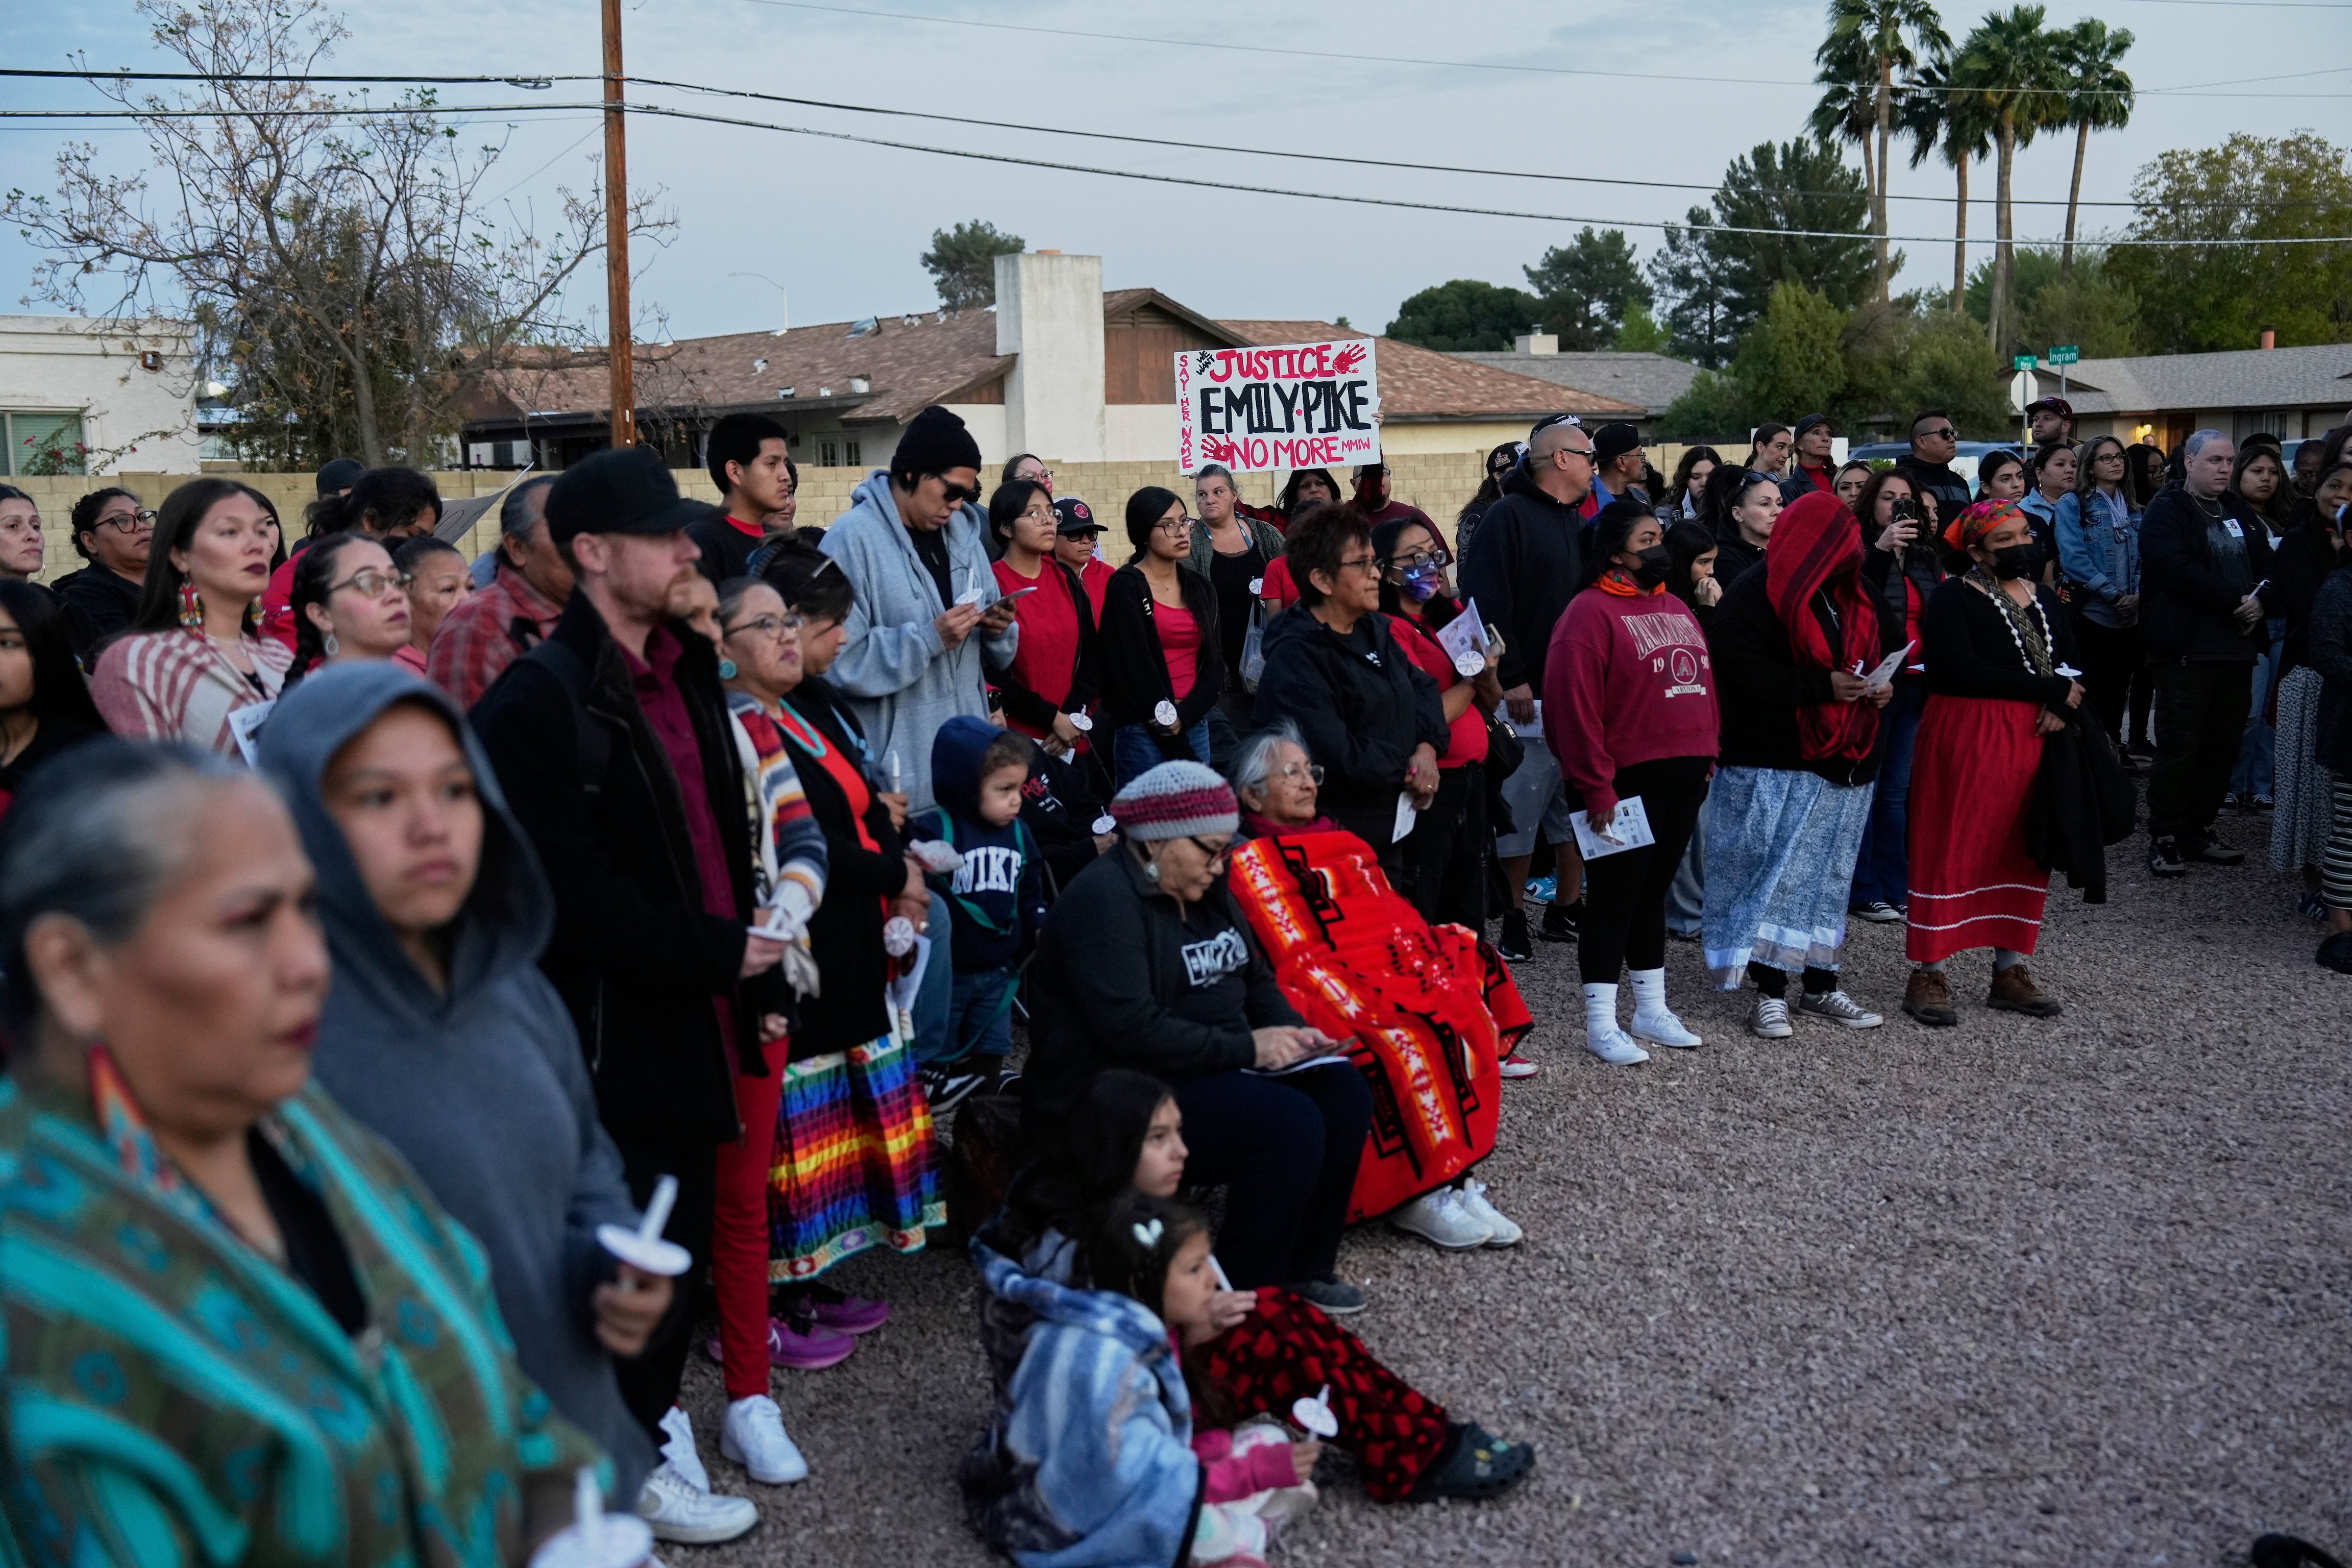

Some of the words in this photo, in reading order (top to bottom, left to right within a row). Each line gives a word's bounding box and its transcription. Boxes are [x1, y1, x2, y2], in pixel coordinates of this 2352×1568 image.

[1195, 354, 1215, 375] WANT
[1196, 351, 1210, 363] WE
[1210, 344, 1336, 383] JUSTICE
[2049, 352, 2076, 364] Ingram
[1179, 355, 1190, 391] SAY
[1181, 397, 1191, 422] HER
[1200, 382, 1300, 434] EMILY
[1302, 380, 1371, 434] PIKE
[1181, 427, 1194, 469] NAME
[1230, 437, 1269, 470] NO
[1274, 436, 1345, 468] MORE
[1342, 436, 1371, 453] MMIW
[1652, 657, 1665, 673] 19
